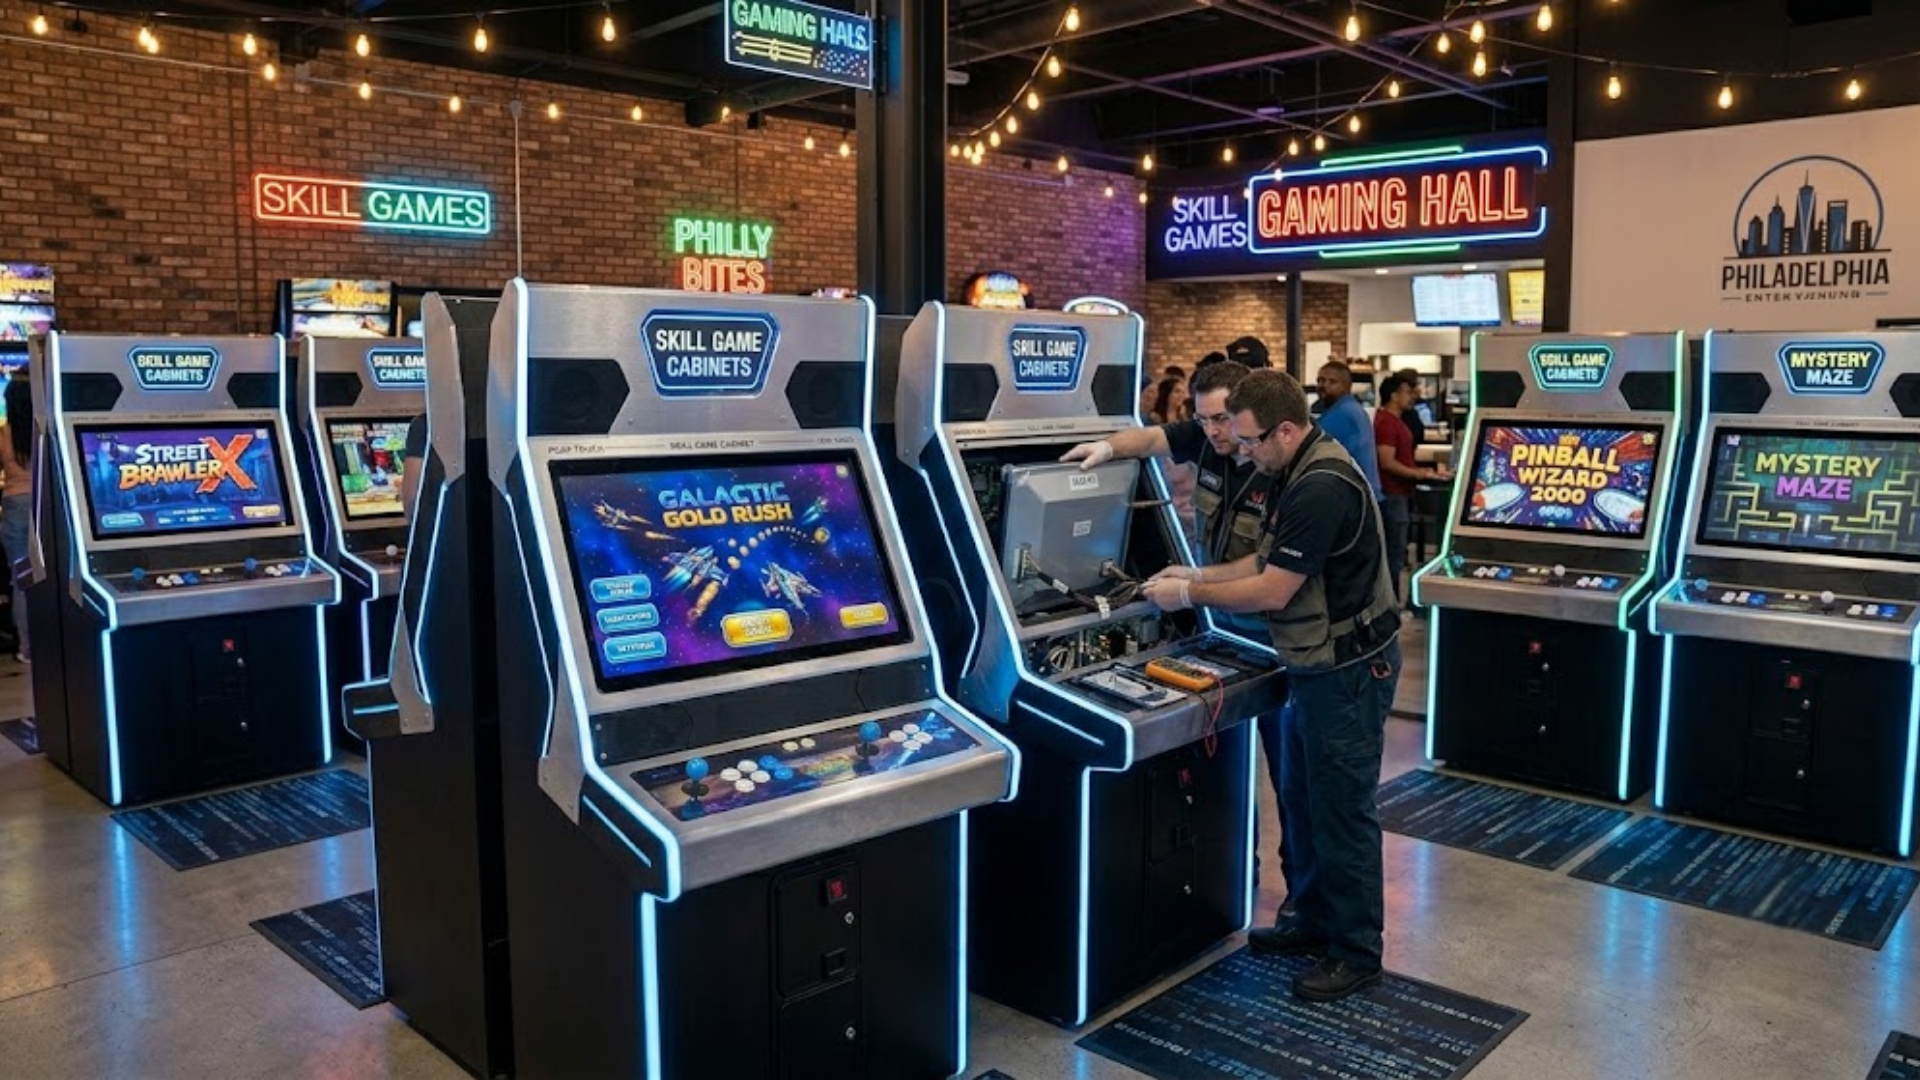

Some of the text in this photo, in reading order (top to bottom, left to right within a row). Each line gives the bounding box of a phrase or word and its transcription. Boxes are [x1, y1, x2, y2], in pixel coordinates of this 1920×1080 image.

[732, 1, 817, 41] GAMING
[263, 182, 484, 227] SKILL GAMES
[1173, 194, 1238, 224] SKILL
[1257, 167, 1528, 238] GAMING HALL
[674, 218, 773, 258] PHILLY
[1164, 221, 1248, 252] GAMES
[682, 256, 766, 294] BITES
[1721, 258, 1890, 290] PHILADELPHIA
[655, 329, 762, 352] SKILL GAME
[666, 356, 752, 377] CABINETS
[1790, 352, 1871, 368] MYSTERY
[1806, 369, 1854, 385] MAZE
[119, 434, 257, 493] BRAWLER X
[135, 443, 210, 464] STREET
[1510, 444, 1620, 473] PINBALL
[1755, 452, 1881, 477] MYSTERY
[1517, 467, 1608, 489] WIZARD
[1776, 476, 1853, 499] MAZE
[658, 481, 790, 509] GALACTIC
[1530, 486, 1586, 504] 2000
[663, 502, 793, 528] GOLD RUSH
